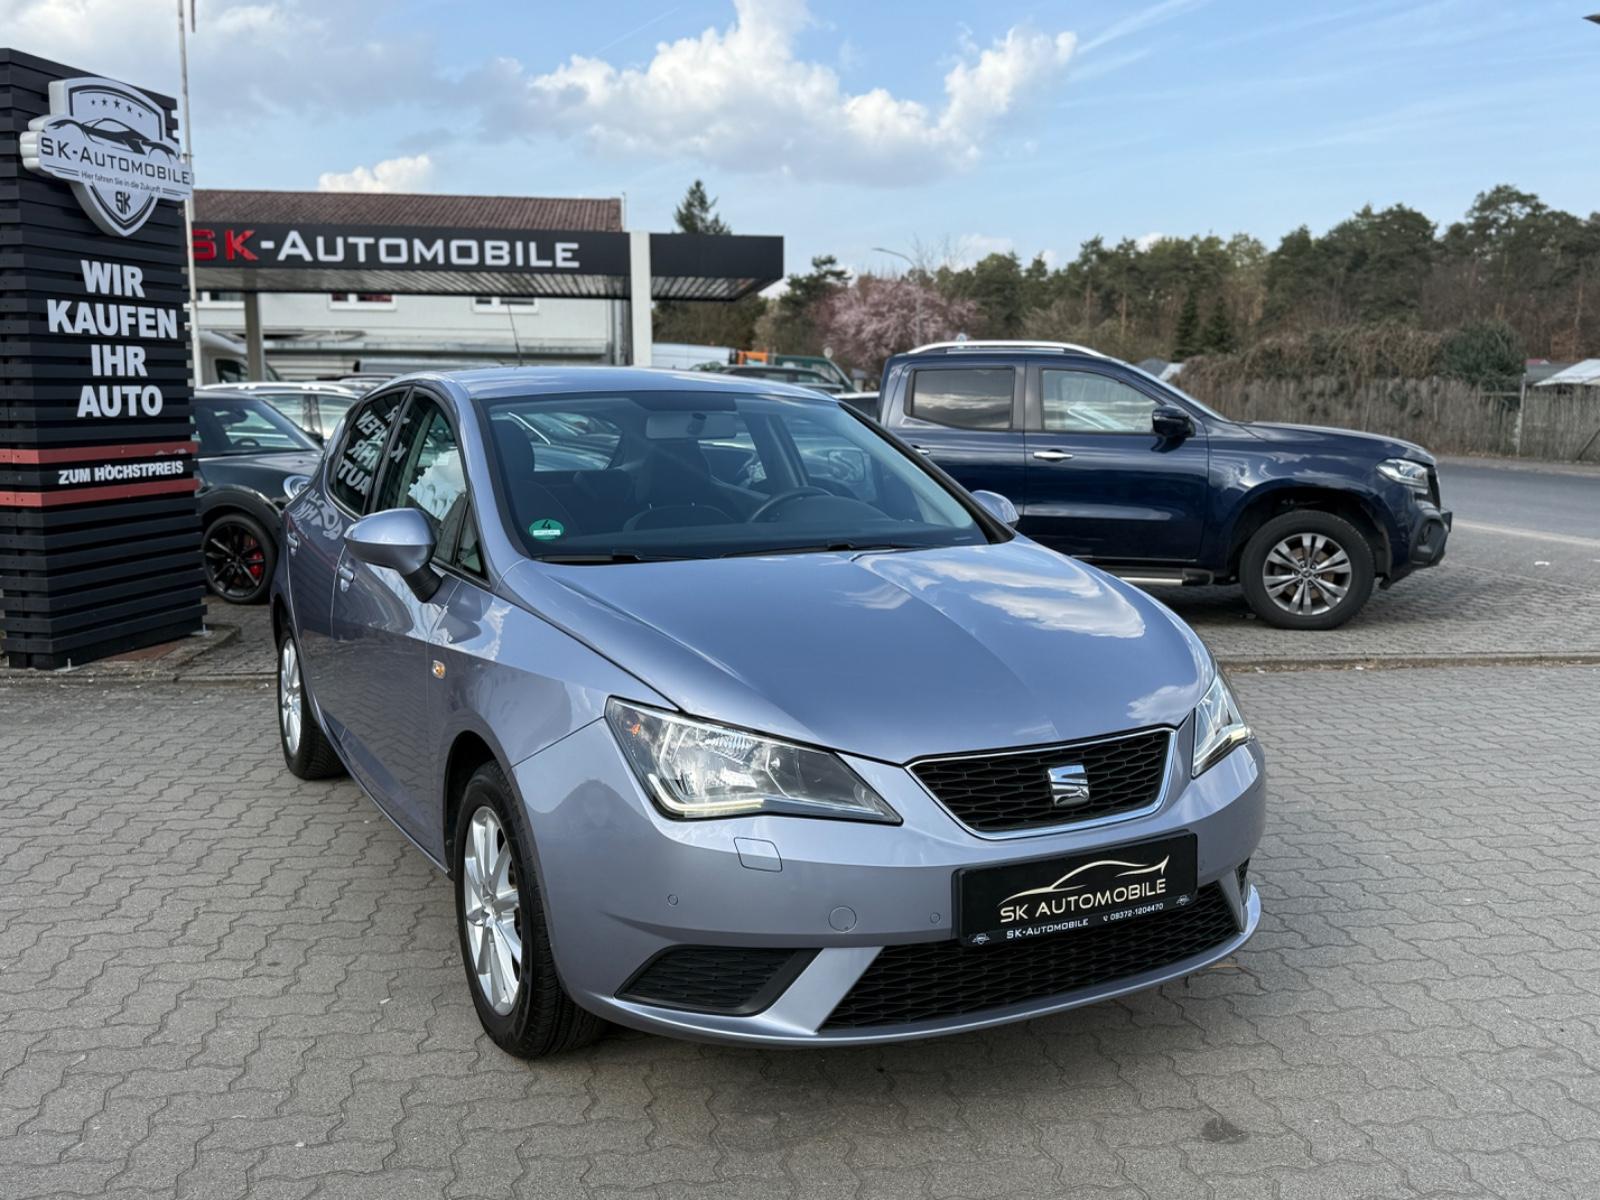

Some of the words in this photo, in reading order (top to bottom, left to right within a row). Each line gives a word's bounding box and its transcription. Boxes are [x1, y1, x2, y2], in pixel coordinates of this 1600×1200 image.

[41, 136, 191, 185] SK-AUTOMOBILE
[81, 170, 94, 180] Hier
[95, 174, 114, 182] fahren
[80, 259, 146, 298] WIR
[47, 298, 178, 339] KAUFEN
[90, 344, 148, 377] IHR
[77, 385, 163, 418] AUTO
[58, 467, 91, 485] ZUM
[94, 461, 184, 481] HÖCHSTPREIS
[541, 519, 552, 530] 4
[1000, 903, 1029, 923] SK
[1035, 878, 1166, 919] AUTOMOBILE
